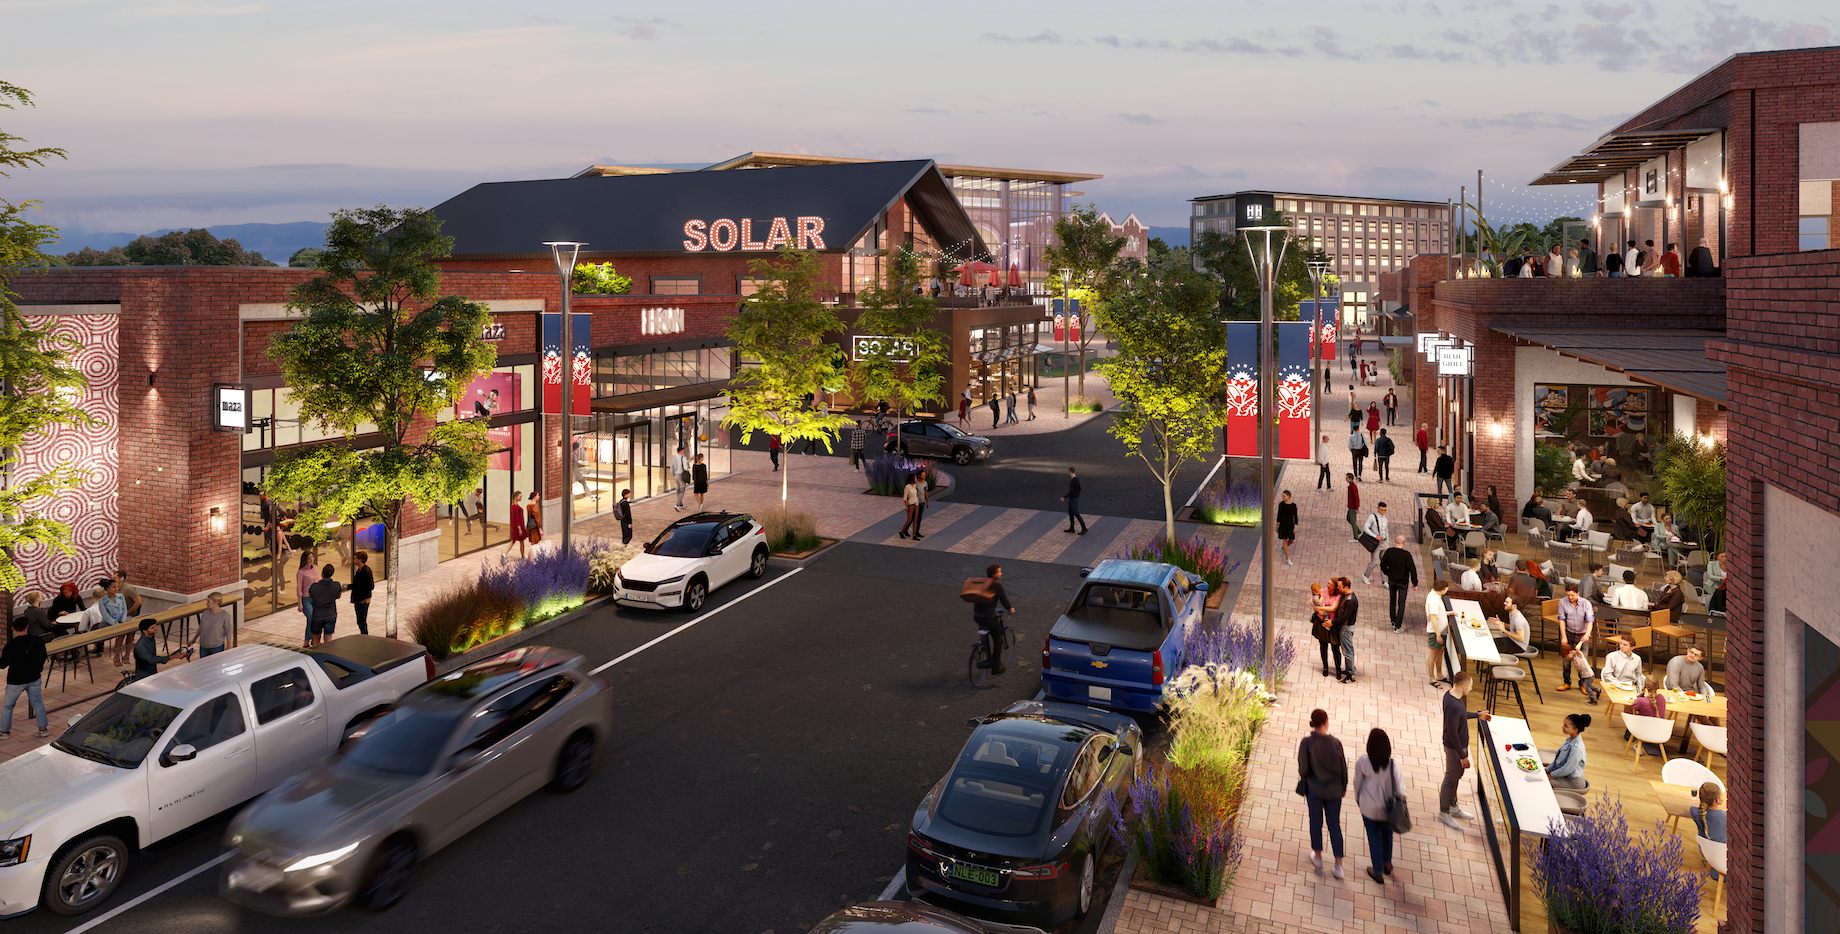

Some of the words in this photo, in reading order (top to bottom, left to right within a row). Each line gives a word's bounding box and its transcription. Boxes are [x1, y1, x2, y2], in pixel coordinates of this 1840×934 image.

[683, 215, 827, 251] SOLAR
[480, 324, 507, 340] aza
[222, 401, 242, 412] maza
[954, 864, 997, 886] NLE-003
